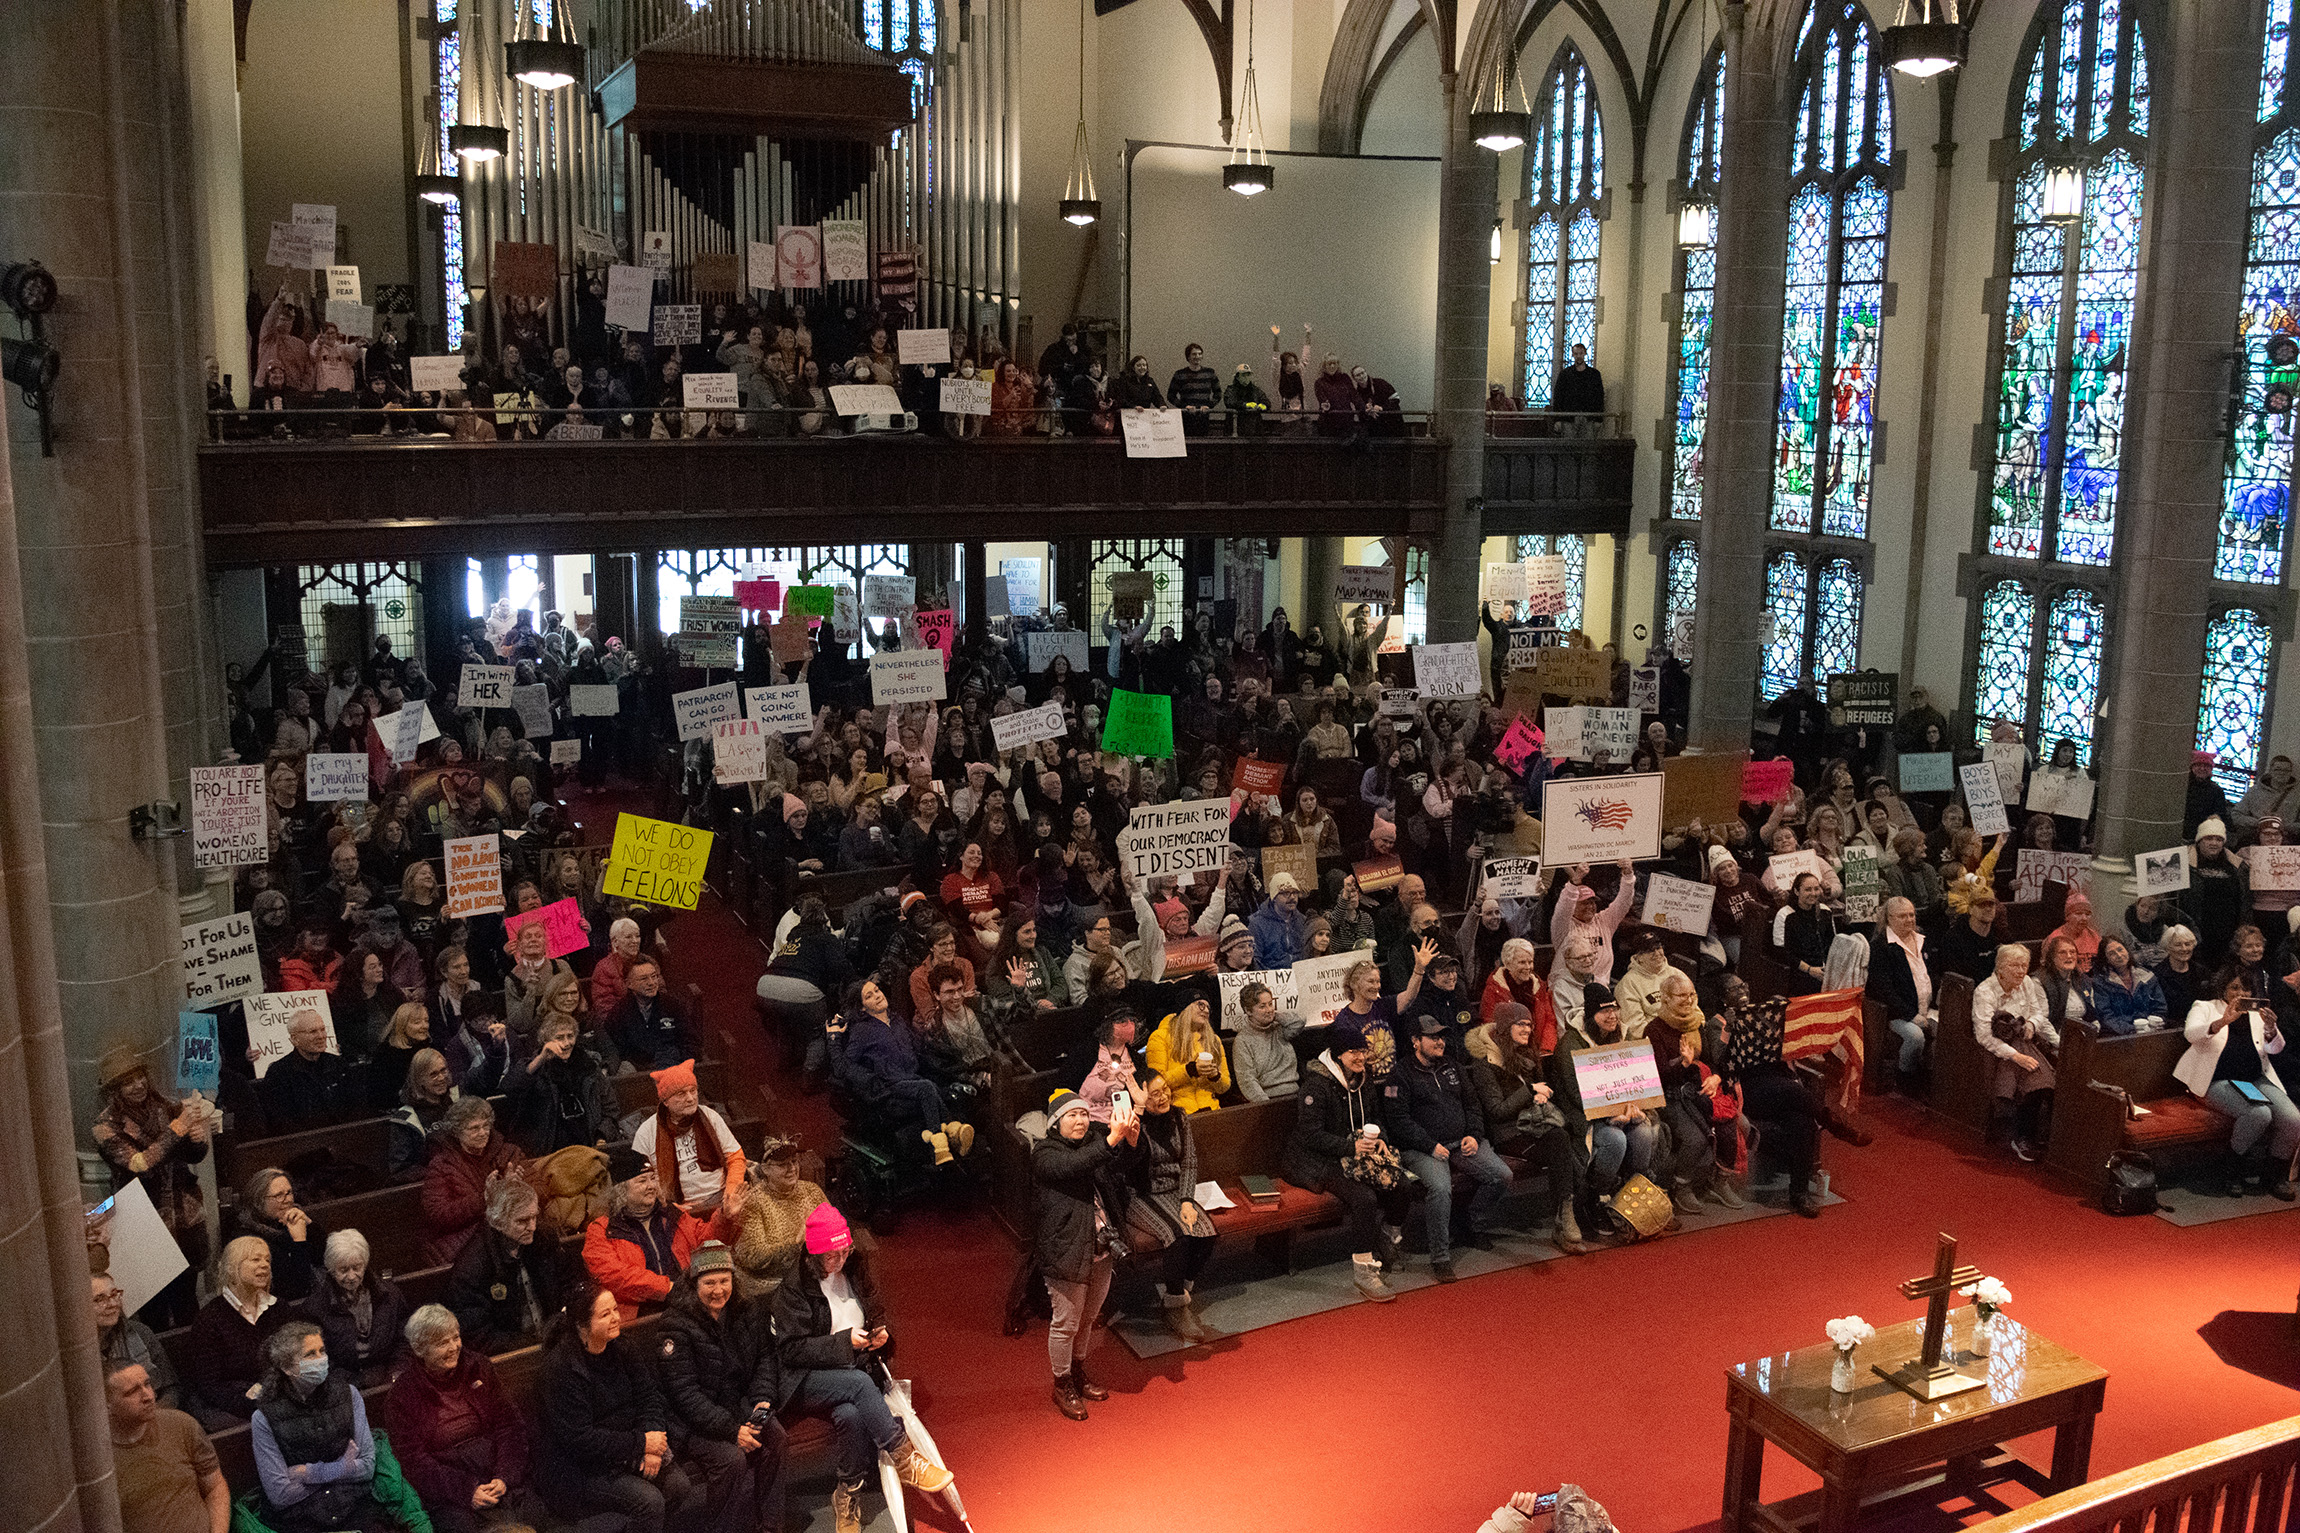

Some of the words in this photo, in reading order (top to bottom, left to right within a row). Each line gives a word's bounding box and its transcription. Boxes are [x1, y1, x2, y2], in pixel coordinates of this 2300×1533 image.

[973, 382, 988, 390] FREE
[706, 394, 738, 404] REVENGE
[955, 404, 975, 412] FREE
[751, 563, 786, 575] FREE
[1335, 585, 1356, 599] MAD
[1357, 586, 1389, 600] WOMAN
[681, 620, 710, 631] TRUST
[711, 619, 740, 632] WOMEN
[916, 614, 951, 629] SMASH
[1510, 632, 1536, 648] NOT
[1539, 632, 1561, 647] MY
[897, 672, 917, 681] SHE
[1422, 669, 1431, 677] OF
[474, 683, 503, 699] HER
[880, 685, 934, 697] PERSISTED
[1429, 682, 1465, 697] BURN
[1632, 681, 1657, 691] FAFO
[1847, 681, 1890, 696] RACISTS
[677, 690, 734, 711] PATRIARCHY
[753, 692, 778, 702] WE'RE
[781, 690, 800, 700] NOT
[689, 706, 709, 719] CAN
[711, 704, 725, 714] GO
[760, 702, 796, 713] GOING
[1587, 708, 1601, 720] BE
[1609, 708, 1633, 721] THE
[762, 712, 807, 724] NYWHERE
[992, 713, 1026, 728] Separation
[1033, 706, 1057, 716] Church
[1009, 721, 1022, 729] and
[1022, 717, 1040, 726] State
[1549, 711, 1570, 725] NOT
[1846, 710, 1894, 724] REFUGEES
[999, 722, 1044, 740] PROTECTS
[1519, 714, 1537, 735] DEAR
[1582, 720, 1629, 732] WOMAN
[1557, 727, 1564, 737] A
[1602, 732, 1638, 745] NEVER
[1109, 741, 1131, 751] FOR
[1995, 749, 2011, 759] MY
[334, 758, 352, 771] my
[193, 768, 218, 781] YOU
[218, 767, 238, 780] ARE
[240, 766, 260, 779] NOT
[1242, 774, 1269, 785] ACTION
[1243, 769, 1274, 780] DEMAND
[1904, 773, 1946, 785] UTERUS
[1963, 765, 1990, 780] BOYS
[194, 780, 263, 800] PRO-LIFE
[311, 788, 325, 797] and
[1569, 783, 1594, 793] SISTERS
[1594, 782, 1602, 791] IN
[1602, 780, 1639, 791] SOLIDARITY
[204, 796, 215, 806] IF
[1969, 787, 1996, 802] BOYS
[194, 805, 261, 817] ANTI-ABORTION
[1972, 808, 2005, 822] RESPECT
[238, 814, 261, 827] JUST
[1130, 813, 1163, 831] WITH
[1166, 810, 1201, 827] FEAR
[1203, 806, 1230, 820] FOR
[220, 826, 243, 834] ANTI
[1975, 821, 2006, 834] GIRLS
[633, 820, 661, 846] WE
[667, 824, 696, 852] DO
[1129, 836, 1156, 852] OUR
[1158, 827, 1230, 848] DEMOCRACY
[480, 841, 491, 850] IS
[1567, 841, 1600, 852] WASHINGTON
[1601, 840, 1612, 850] DC
[1613, 839, 1636, 849] MARCH
[194, 846, 267, 866] HEALTHCARE
[1607, 849, 1620, 858] 2017
[1846, 848, 1869, 862] OUR
[2051, 853, 2081, 866] Time
[450, 856, 470, 870] NO
[621, 844, 655, 869] NOT
[660, 850, 699, 878] OBEY
[1134, 854, 1147, 878] I
[1149, 845, 1229, 874] DISSENT
[1493, 859, 1533, 871] WOMEN'S
[1359, 870, 1382, 881] DESARMA
[1496, 867, 1529, 877] MARCH
[620, 867, 699, 908] FELONS
[450, 898, 473, 915] CAN
[199, 927, 226, 947] FOR
[226, 921, 251, 939] US
[206, 943, 256, 966] SHAME
[1167, 953, 1198, 969] DISARM
[1198, 949, 1216, 965] HATE
[1221, 970, 1269, 988] RESPECT
[1274, 970, 1293, 984] MY
[185, 982, 214, 1000] FOR
[214, 973, 252, 992] THEM
[1308, 984, 1322, 994] YOU
[1324, 981, 1341, 991] CAN
[249, 997, 273, 1012] WE
[1285, 994, 1299, 1010] MY
[1224, 1003, 1237, 1017] OR
[258, 1012, 291, 1027] GIVE
[185, 1036, 214, 1063] LOVE
[256, 1038, 284, 1057] WE
[1587, 1053, 1613, 1067] SUPPORT
[1603, 1060, 1629, 1072] SISTERS
[1595, 1083, 1608, 1093] NOT
[1612, 1078, 1628, 1089] JUST
[1631, 1074, 1646, 1084] YOUR
[1604, 1084, 1645, 1101] CIS-TERS
